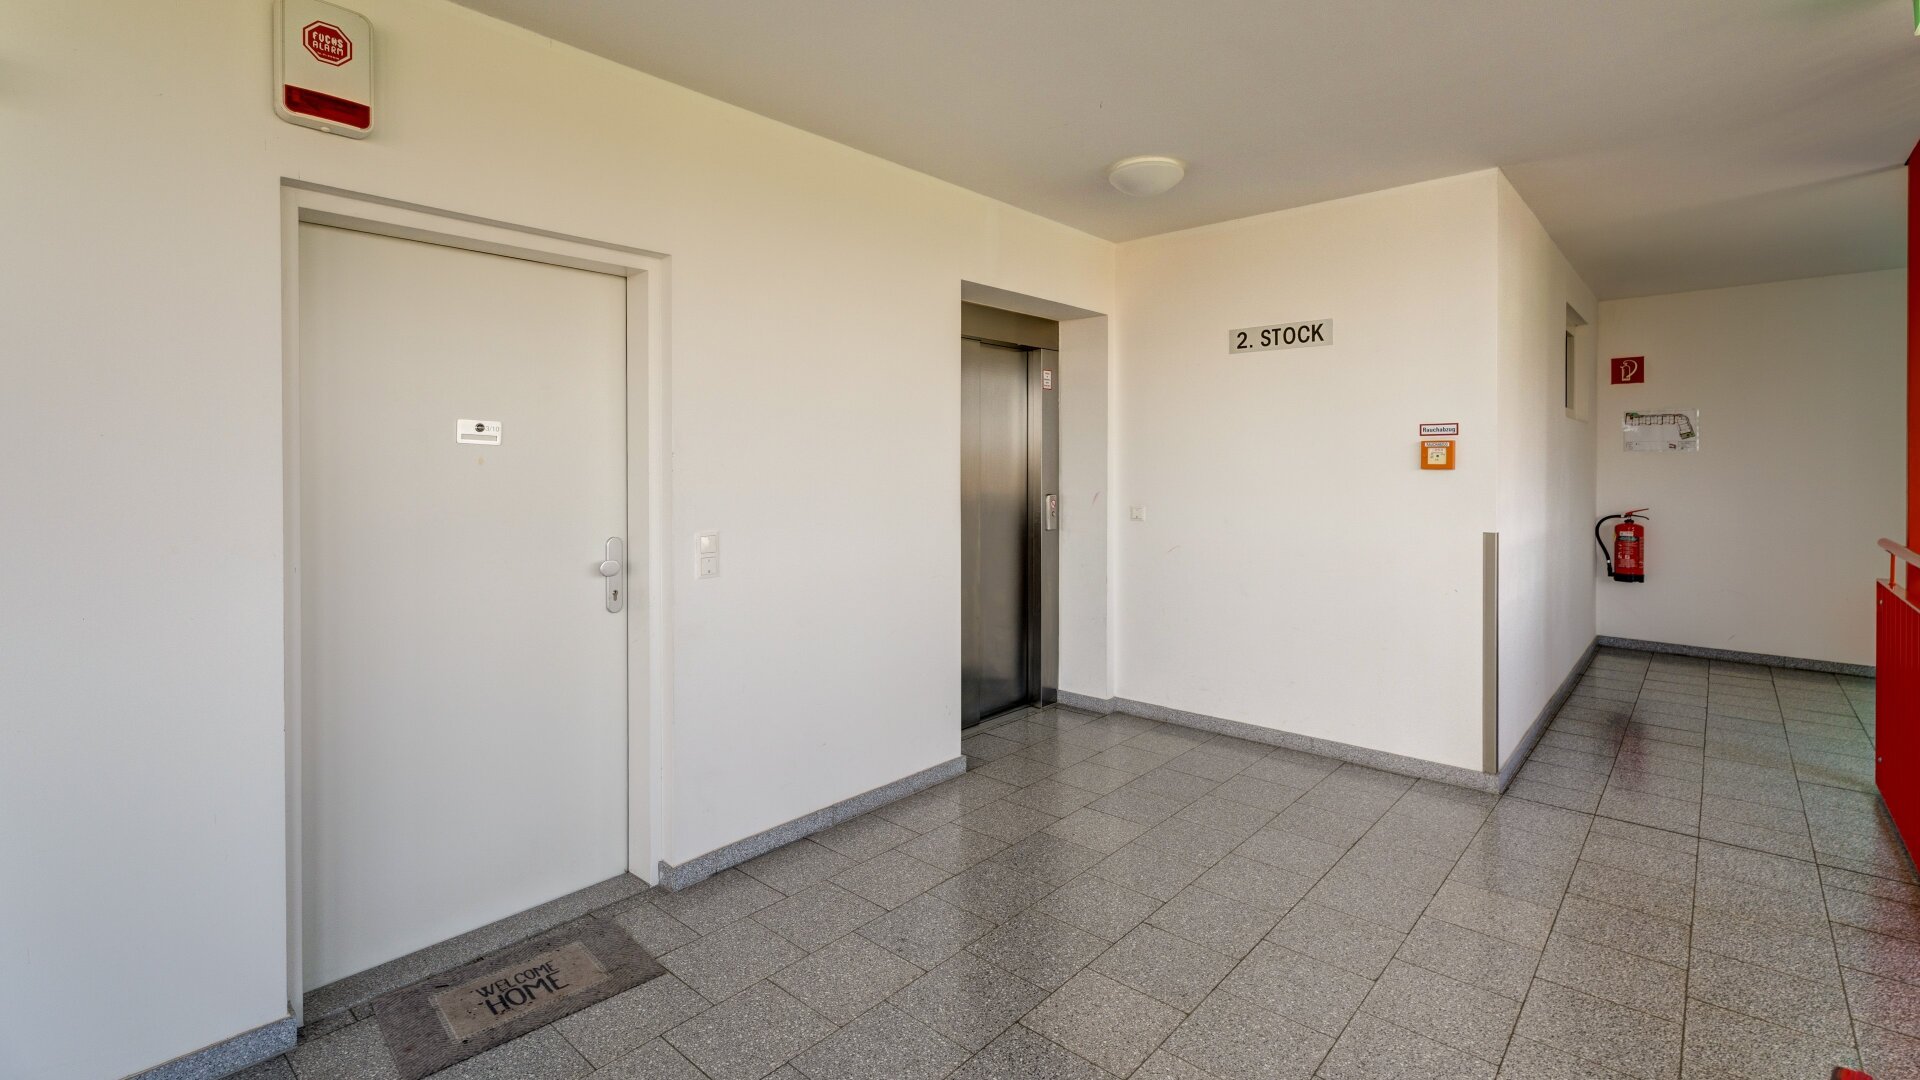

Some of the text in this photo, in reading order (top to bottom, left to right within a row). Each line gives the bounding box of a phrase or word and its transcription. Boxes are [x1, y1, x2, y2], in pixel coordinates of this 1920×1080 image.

[312, 31, 344, 48] FUCHS
[312, 40, 344, 56] ALARM
[1236, 323, 1324, 349] 2. STOCK
[475, 960, 560, 998] WELCOME
[484, 970, 570, 1016] HOME
